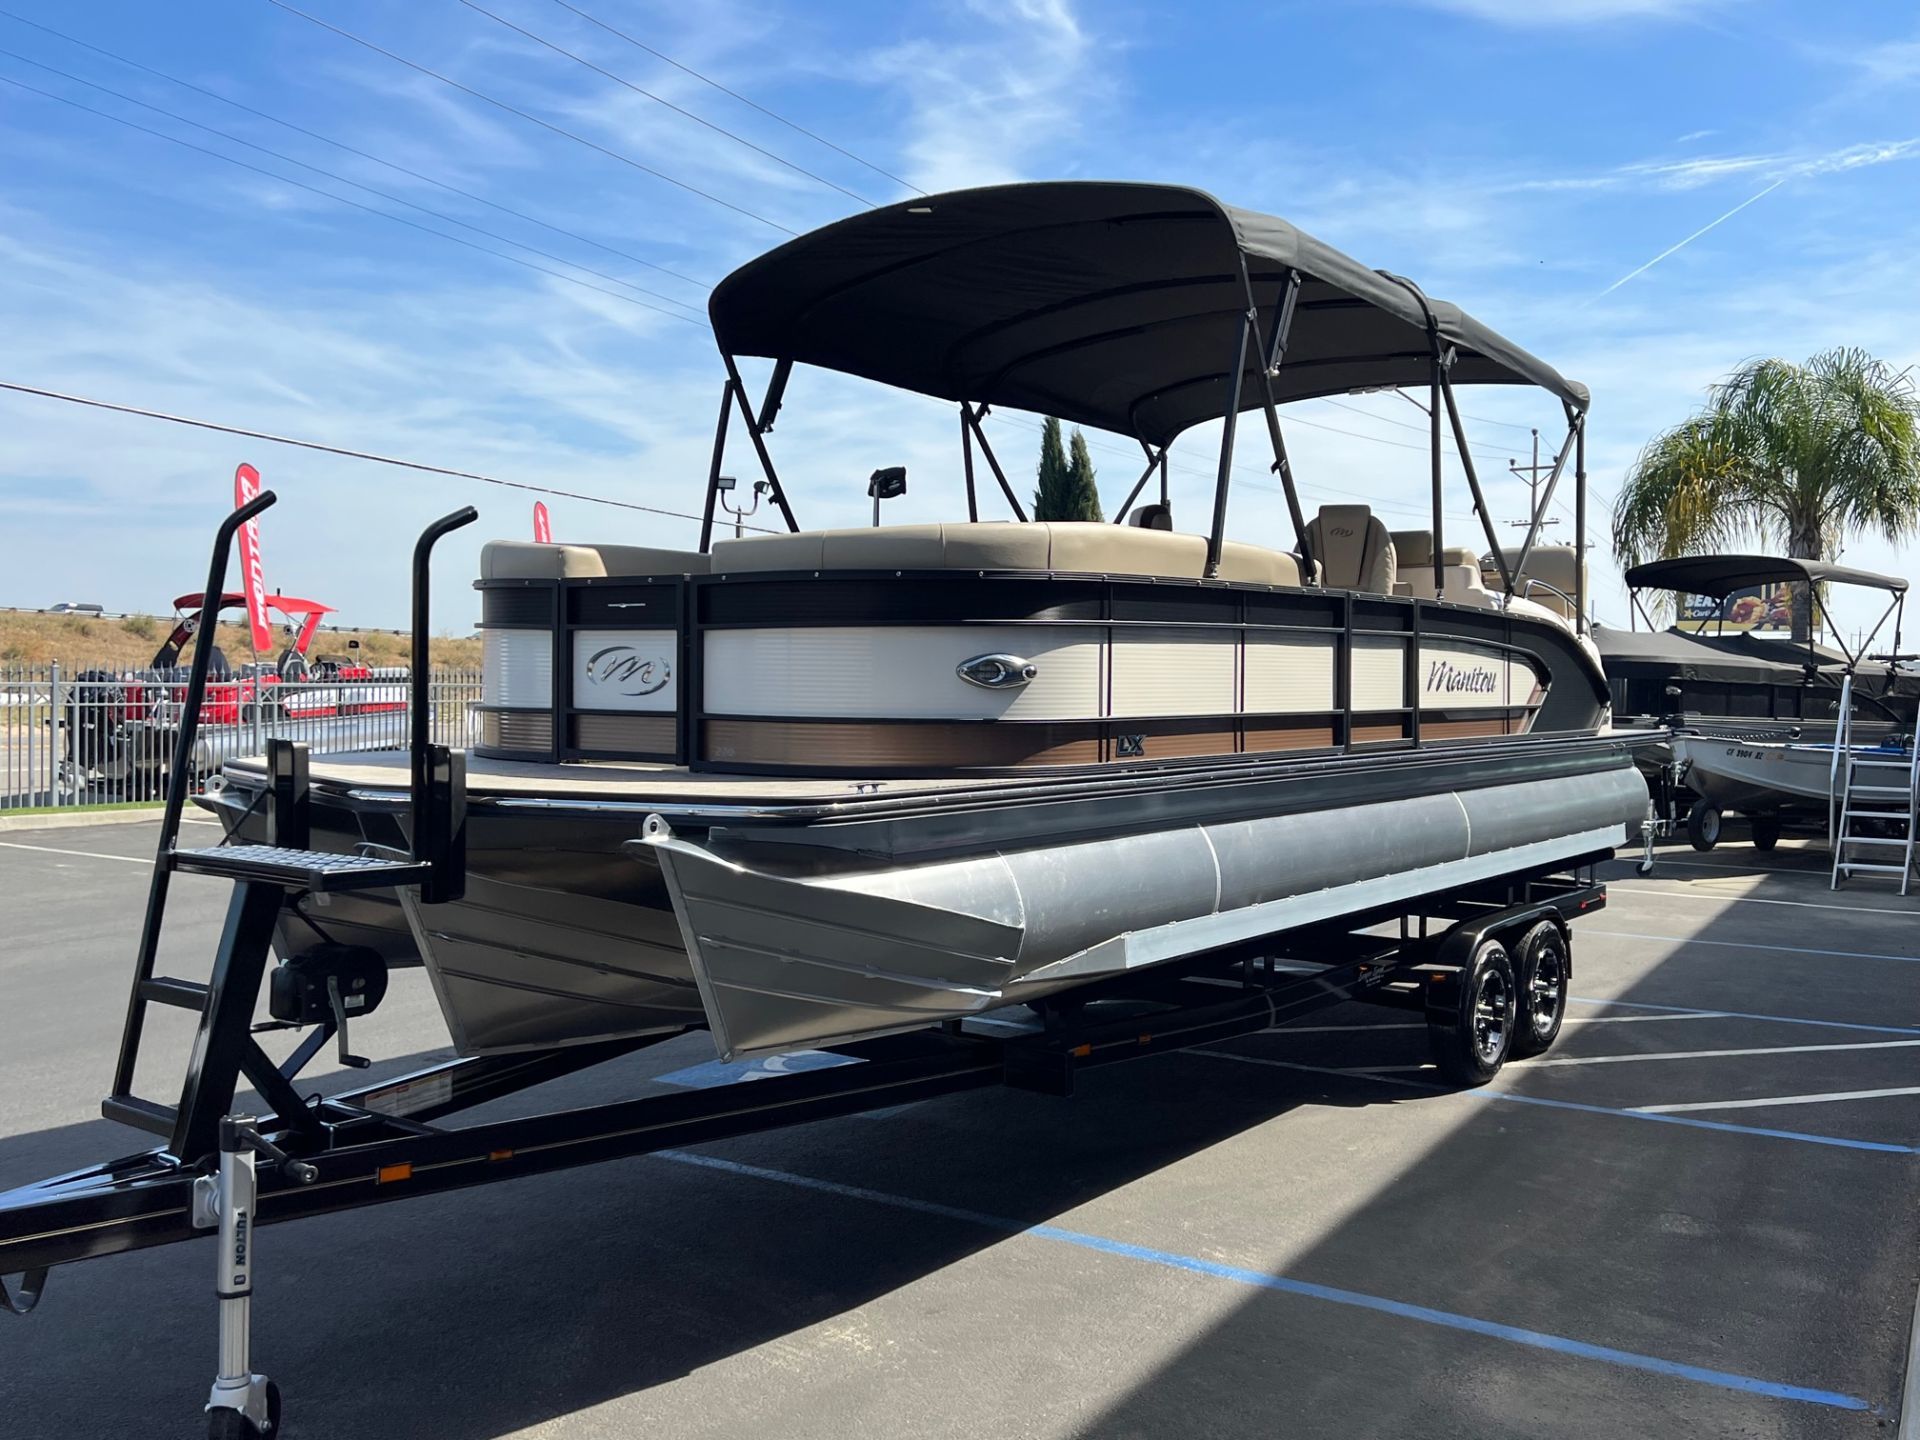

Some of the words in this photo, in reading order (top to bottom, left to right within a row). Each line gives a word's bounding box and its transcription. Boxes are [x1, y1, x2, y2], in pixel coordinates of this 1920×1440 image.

[240, 476, 268, 630] MONTAA
[1427, 661, 1497, 693] Manitou
[1116, 734, 1147, 758] LX
[235, 1211, 247, 1266] FULTON
